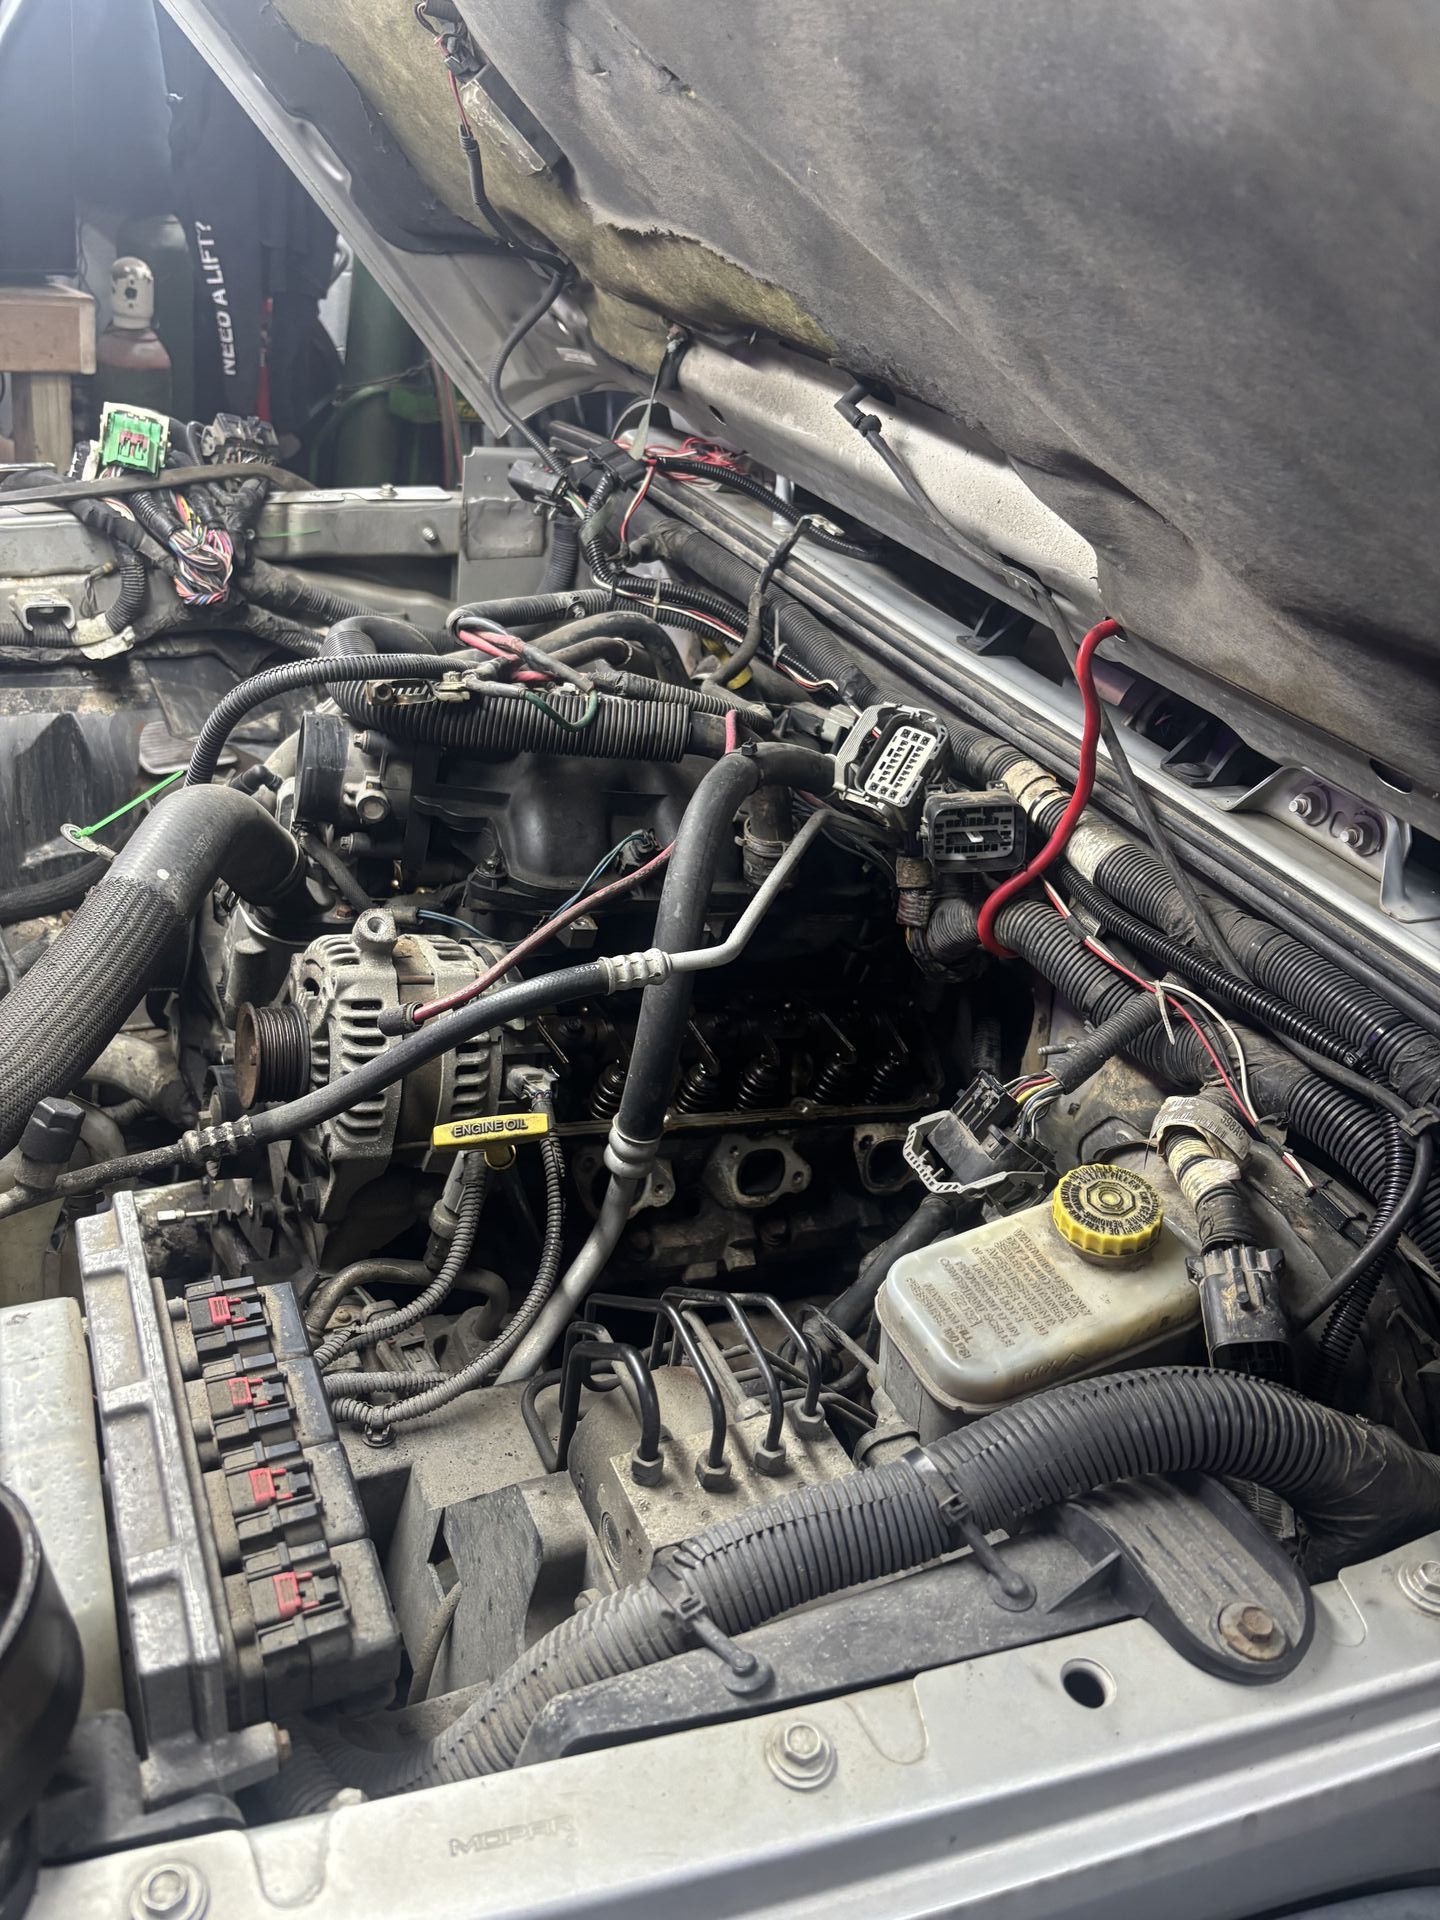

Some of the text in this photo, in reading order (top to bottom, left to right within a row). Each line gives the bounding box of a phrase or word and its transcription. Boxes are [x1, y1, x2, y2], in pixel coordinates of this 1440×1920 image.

[195, 221, 236, 376] NEED A LIFT?
[453, 1118, 528, 1138] ENGINE OIL
[1024, 1259, 1051, 1286] FLUID
[1045, 1283, 1073, 1311] FROM
[1051, 1274, 1074, 1294] USE
[1067, 1292, 1093, 1318] ONLY
[952, 1341, 973, 1360] PSI
[953, 1323, 976, 1343] FILL
[448, 1814, 576, 1857] MOPAR
